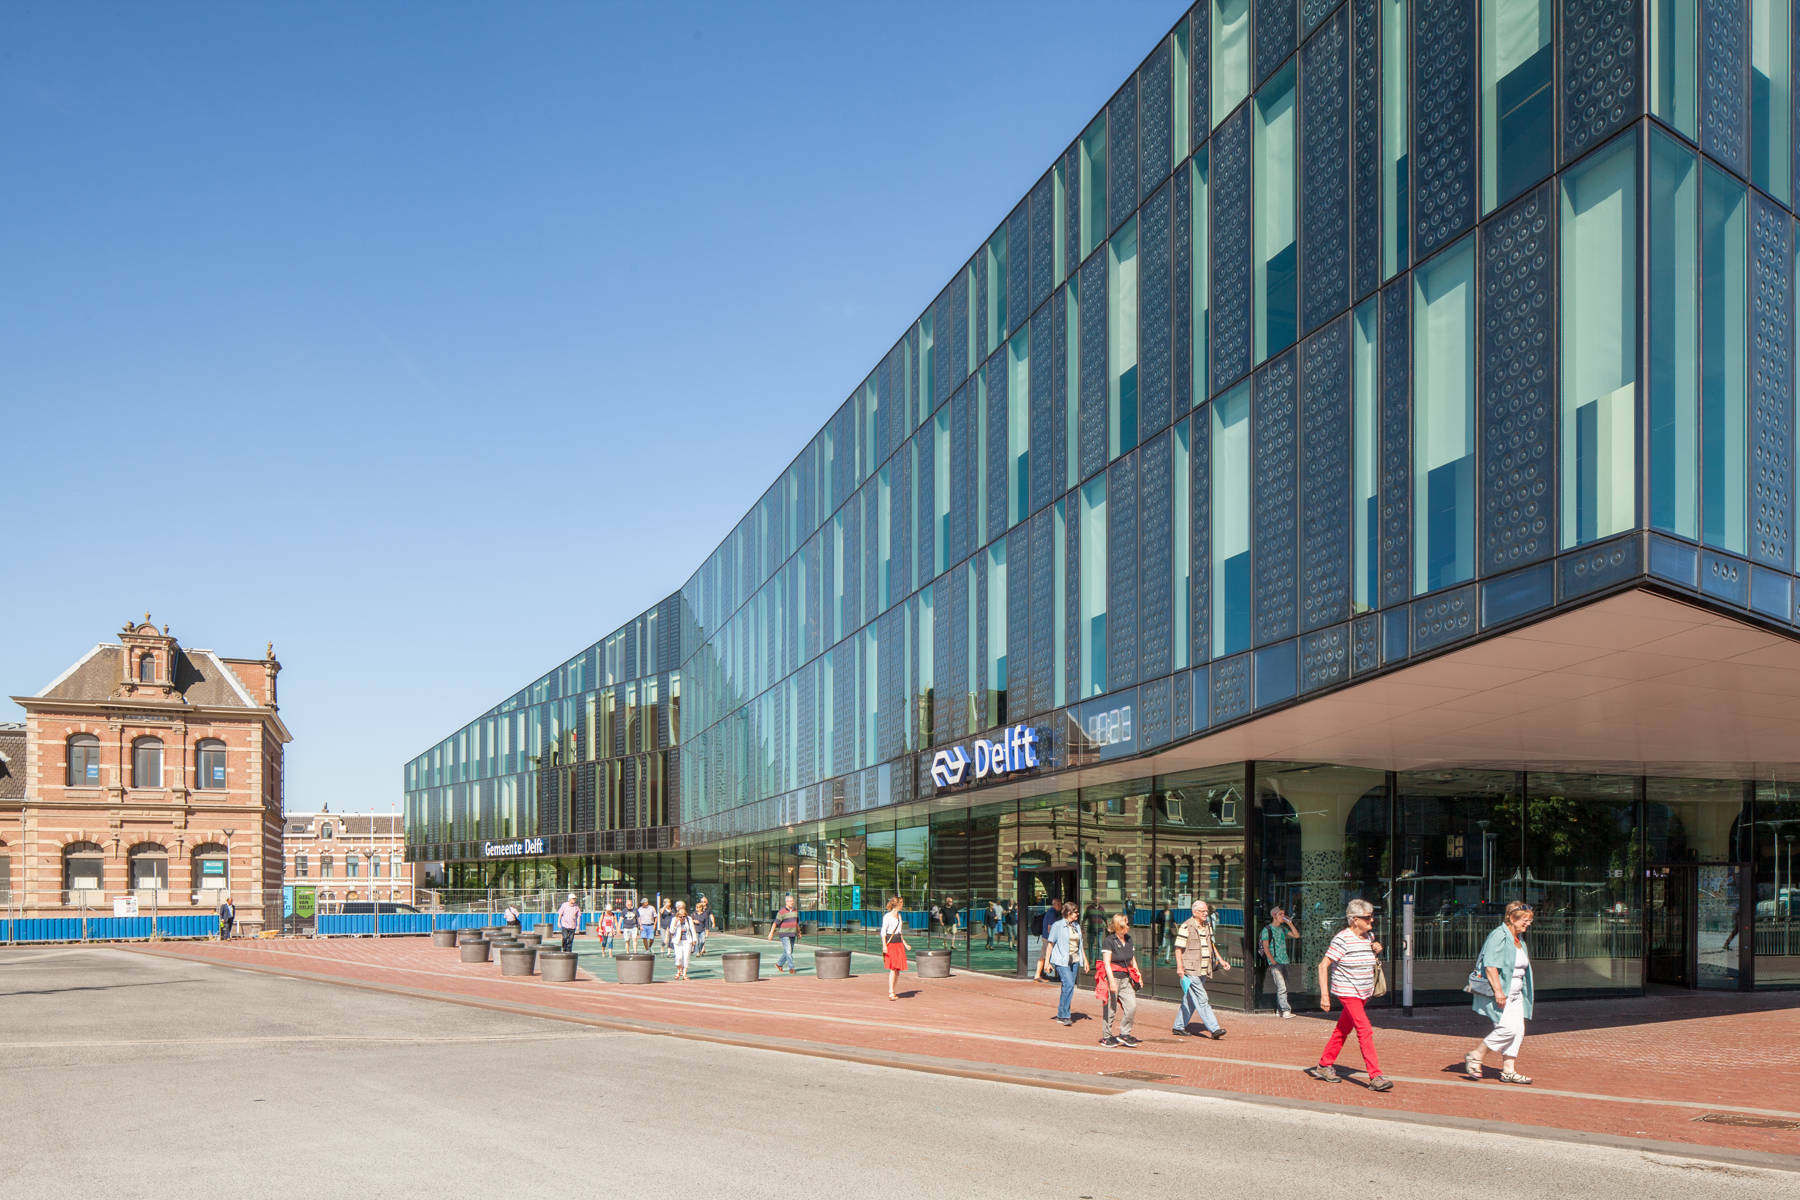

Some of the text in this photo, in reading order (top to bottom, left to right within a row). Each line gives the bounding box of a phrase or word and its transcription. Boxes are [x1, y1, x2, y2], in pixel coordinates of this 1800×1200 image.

[975, 725, 1037, 778] Delft
[485, 838, 543, 856] Gemeente Delft
